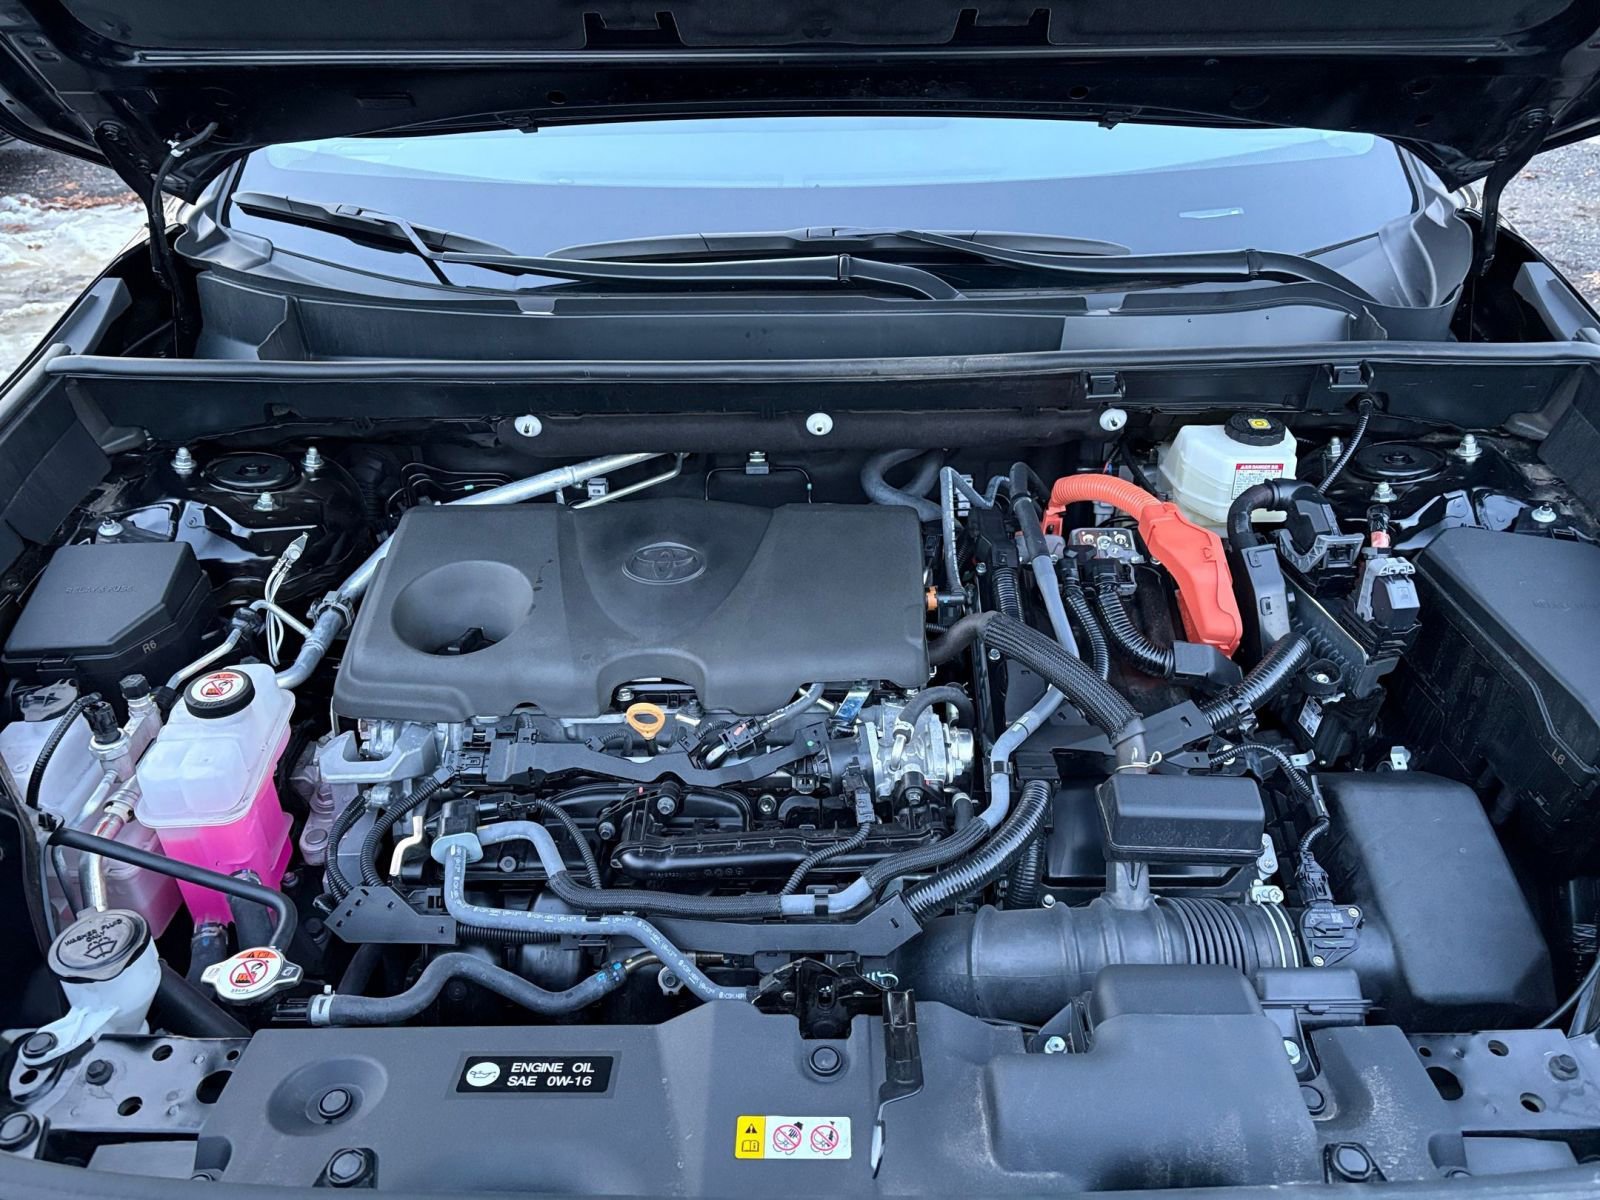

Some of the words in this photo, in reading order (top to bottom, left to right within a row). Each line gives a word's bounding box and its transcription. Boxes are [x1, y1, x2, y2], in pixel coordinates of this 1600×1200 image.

[143, 640, 157, 654] R6
[64, 929, 98, 946] WASHER
[101, 918, 123, 931] FLUID
[86, 931, 105, 943] ONLY
[511, 1062, 564, 1073] ENGINE
[572, 1062, 595, 1073] OIL
[507, 1075, 538, 1087] SAE
[546, 1075, 592, 1087] 0W-16
